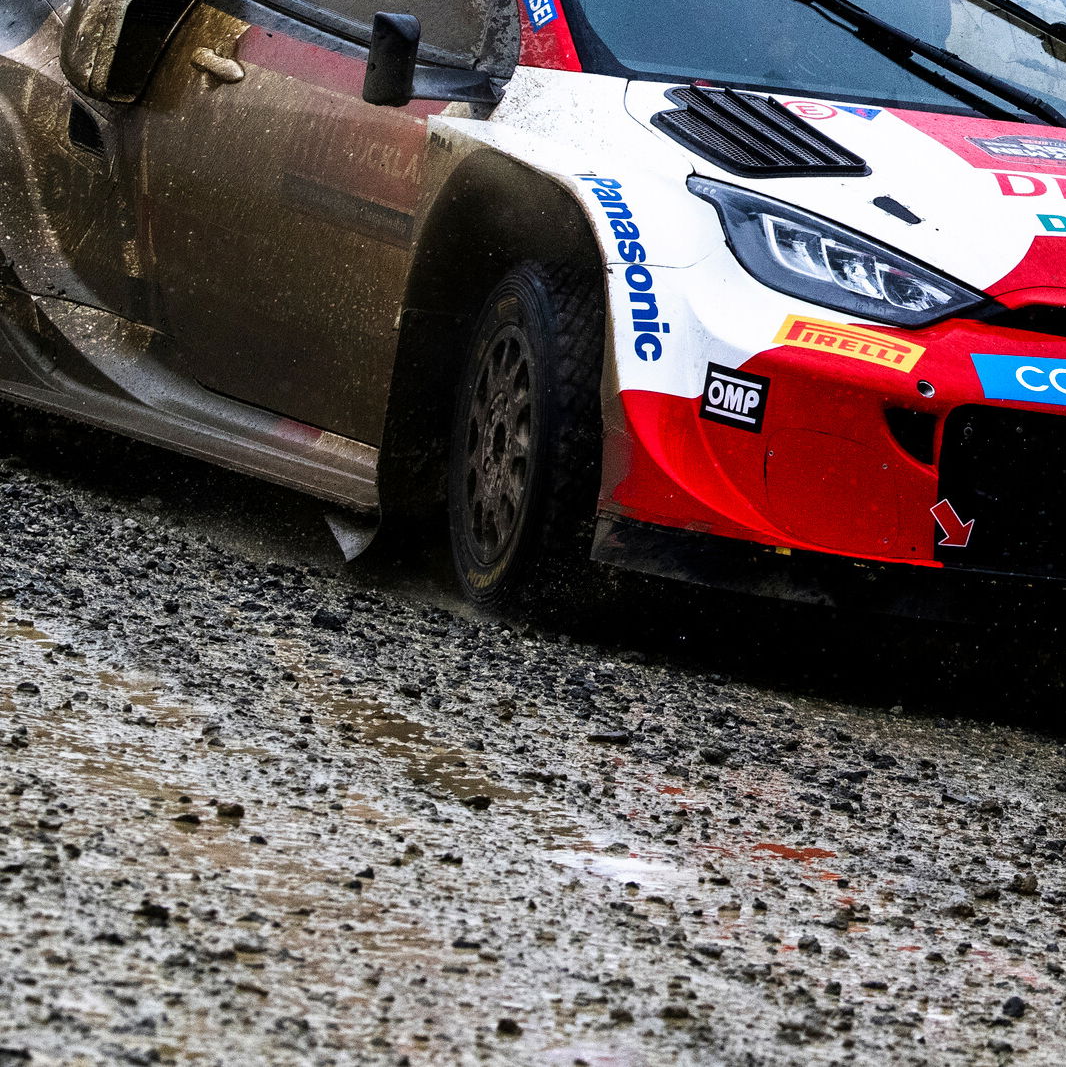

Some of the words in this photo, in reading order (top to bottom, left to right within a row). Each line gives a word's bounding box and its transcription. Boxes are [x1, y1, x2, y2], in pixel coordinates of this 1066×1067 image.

[580, 177, 670, 361] Panasonic
[785, 320, 912, 365] PIRELLI
[707, 380, 760, 414] OMP
